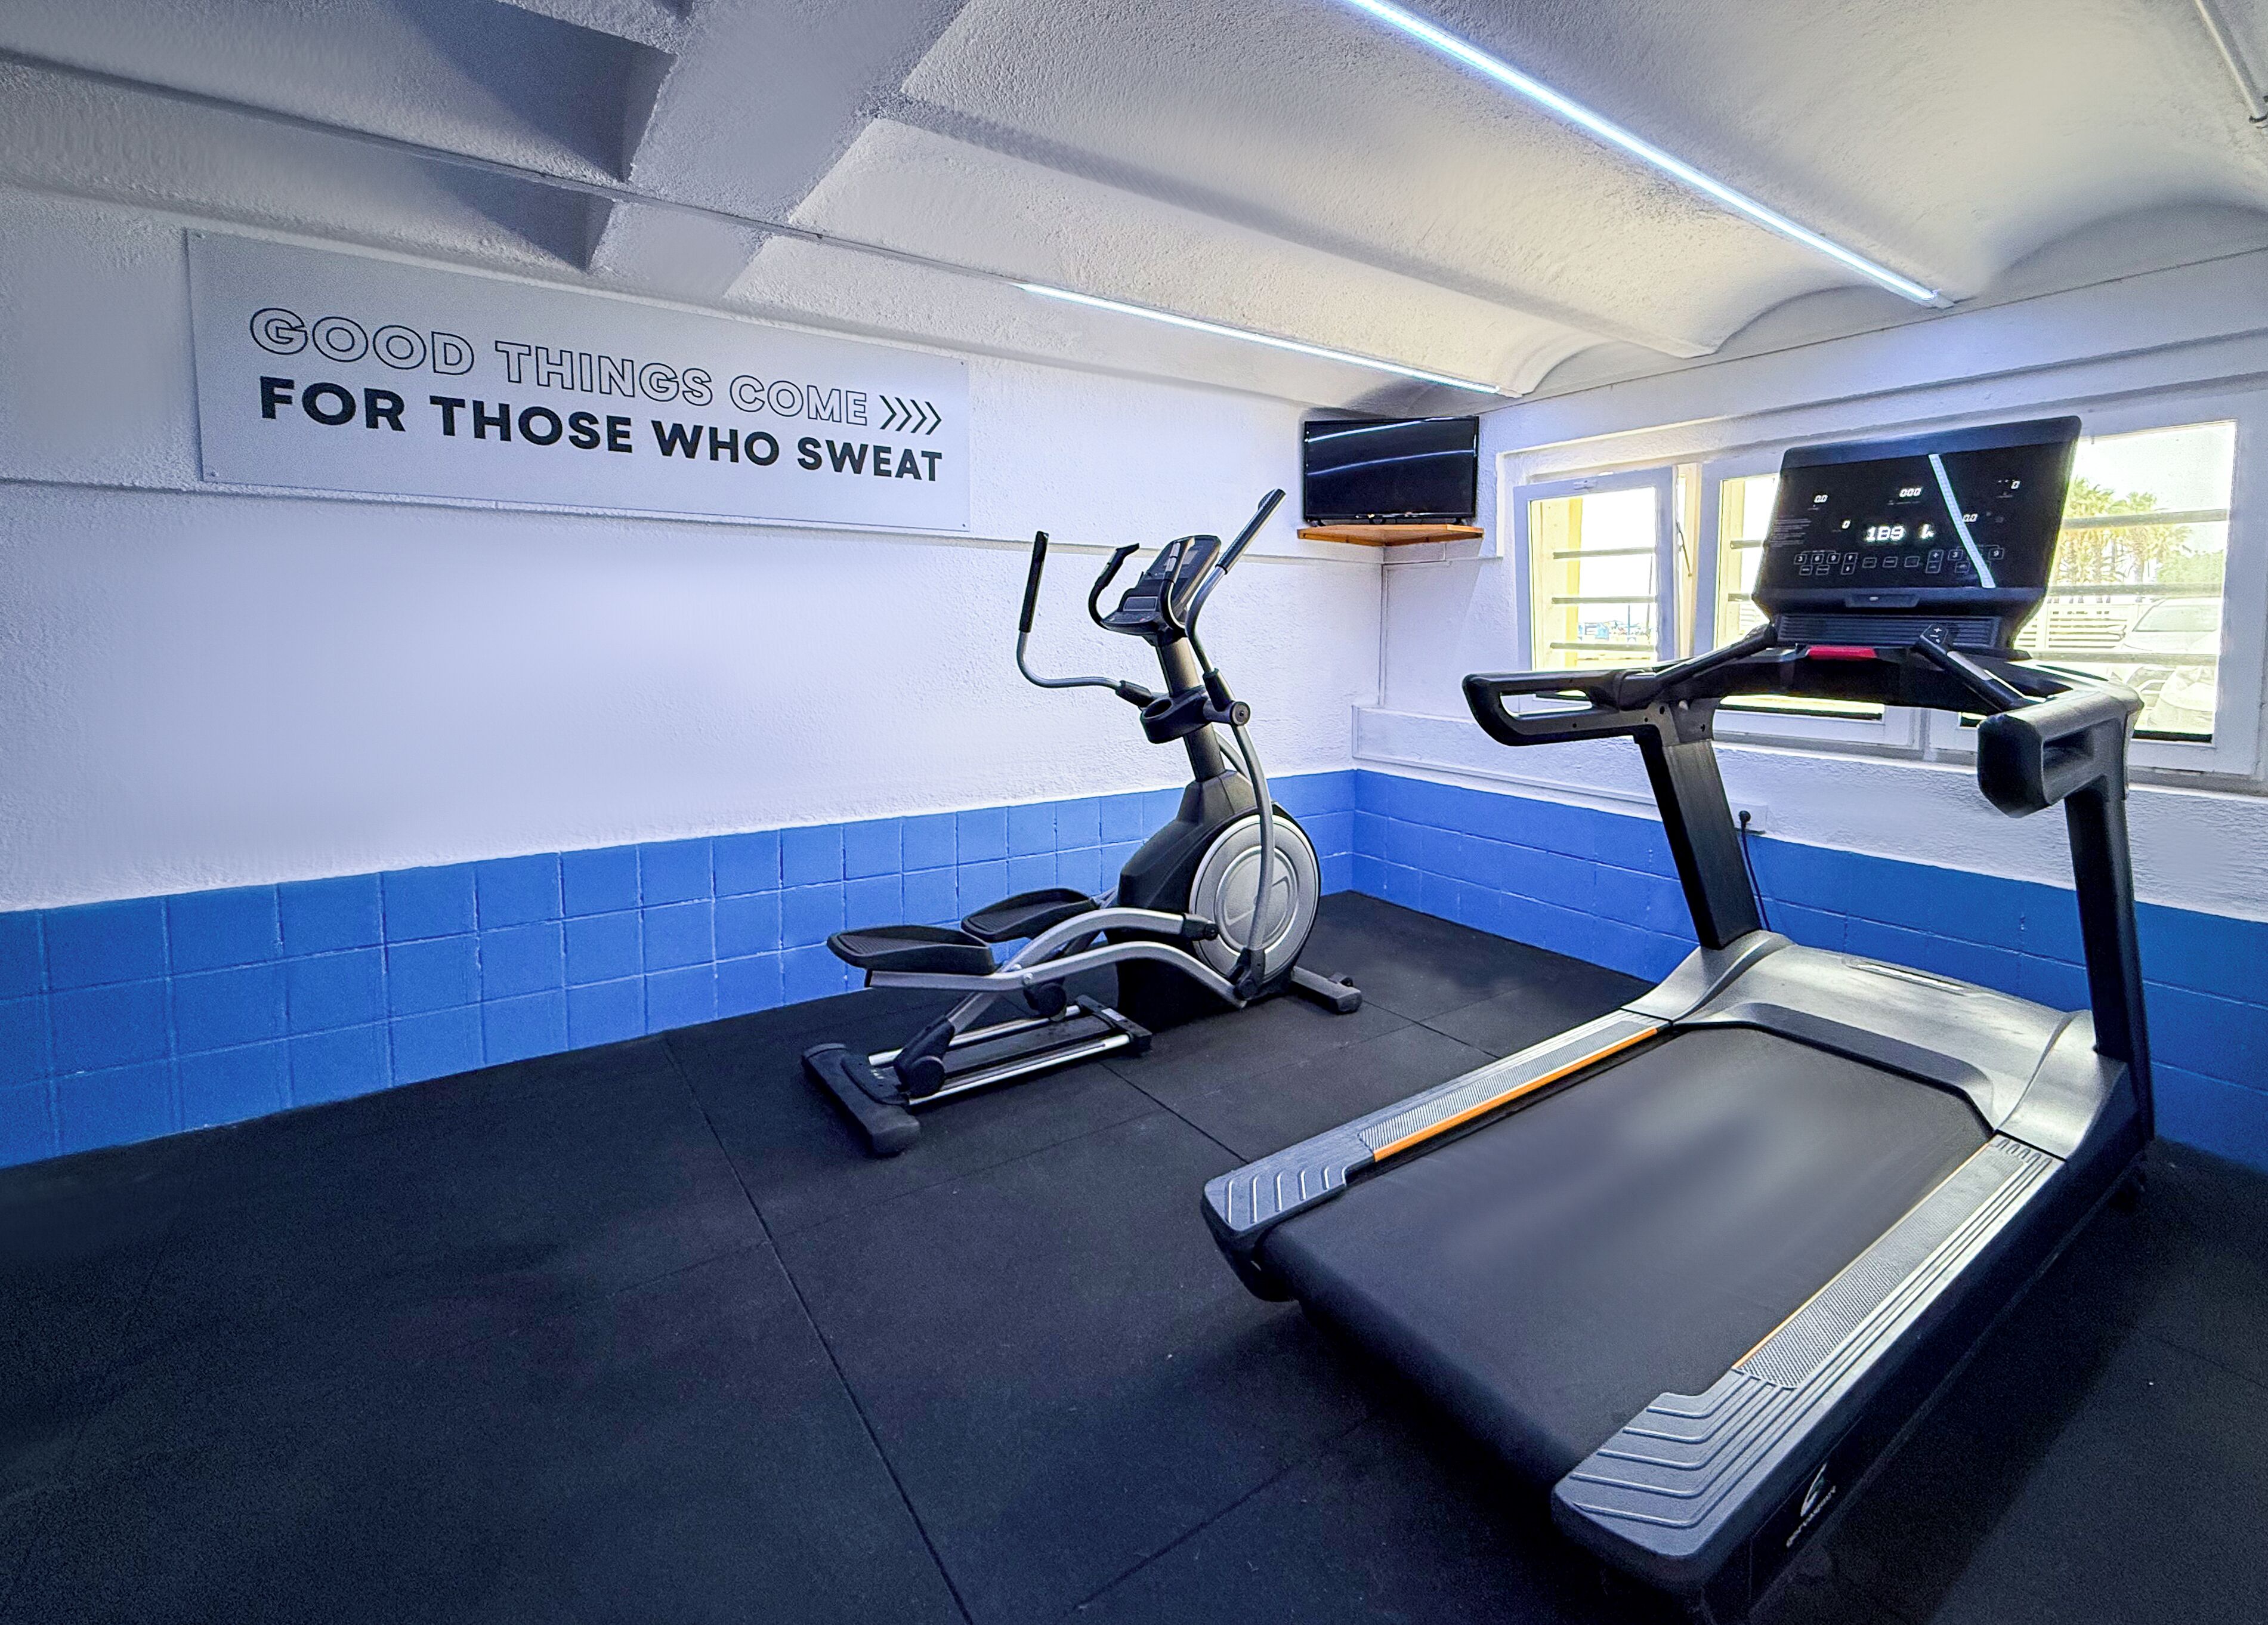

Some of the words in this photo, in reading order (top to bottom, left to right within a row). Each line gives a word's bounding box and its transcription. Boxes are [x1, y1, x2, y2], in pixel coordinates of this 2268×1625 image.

[249, 307, 475, 376] GOOD
[495, 340, 713, 407] THINGS
[729, 375, 867, 427] COME
[259, 375, 406, 432] FOR
[429, 395, 633, 453] THOSE
[651, 419, 780, 467] WHO
[797, 437, 943, 481] SWEAT
